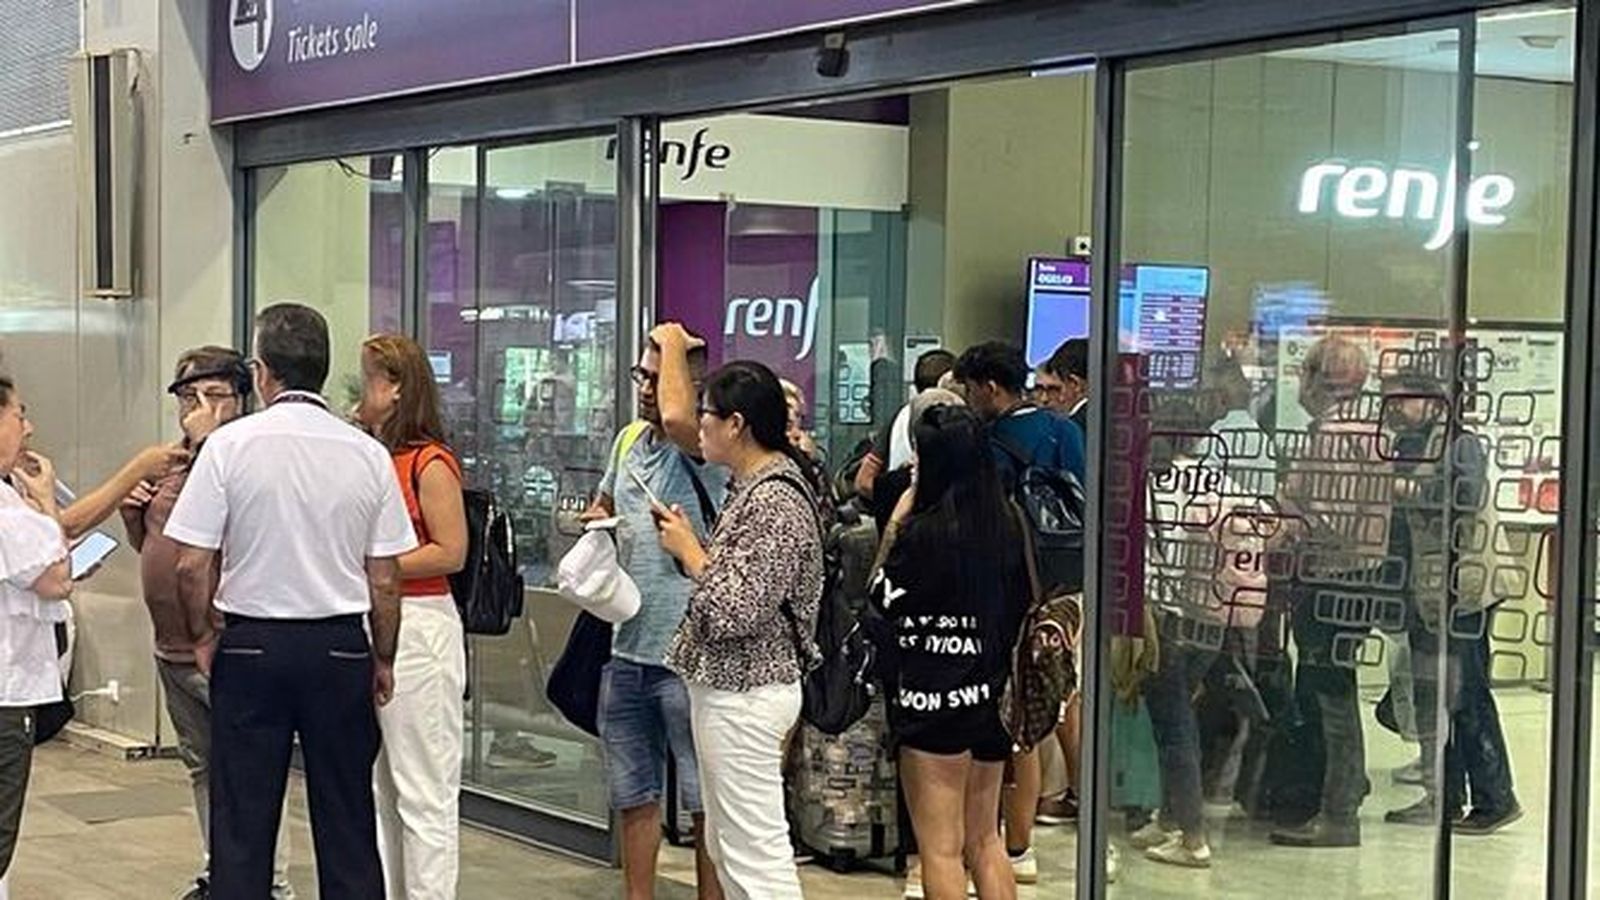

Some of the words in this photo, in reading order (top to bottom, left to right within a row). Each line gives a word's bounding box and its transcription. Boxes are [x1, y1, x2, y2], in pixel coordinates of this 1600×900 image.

[287, 24, 340, 63] Tickets
[343, 12, 378, 53] sale
[605, 127, 731, 181] rnfe
[1299, 138, 1516, 250] renfe
